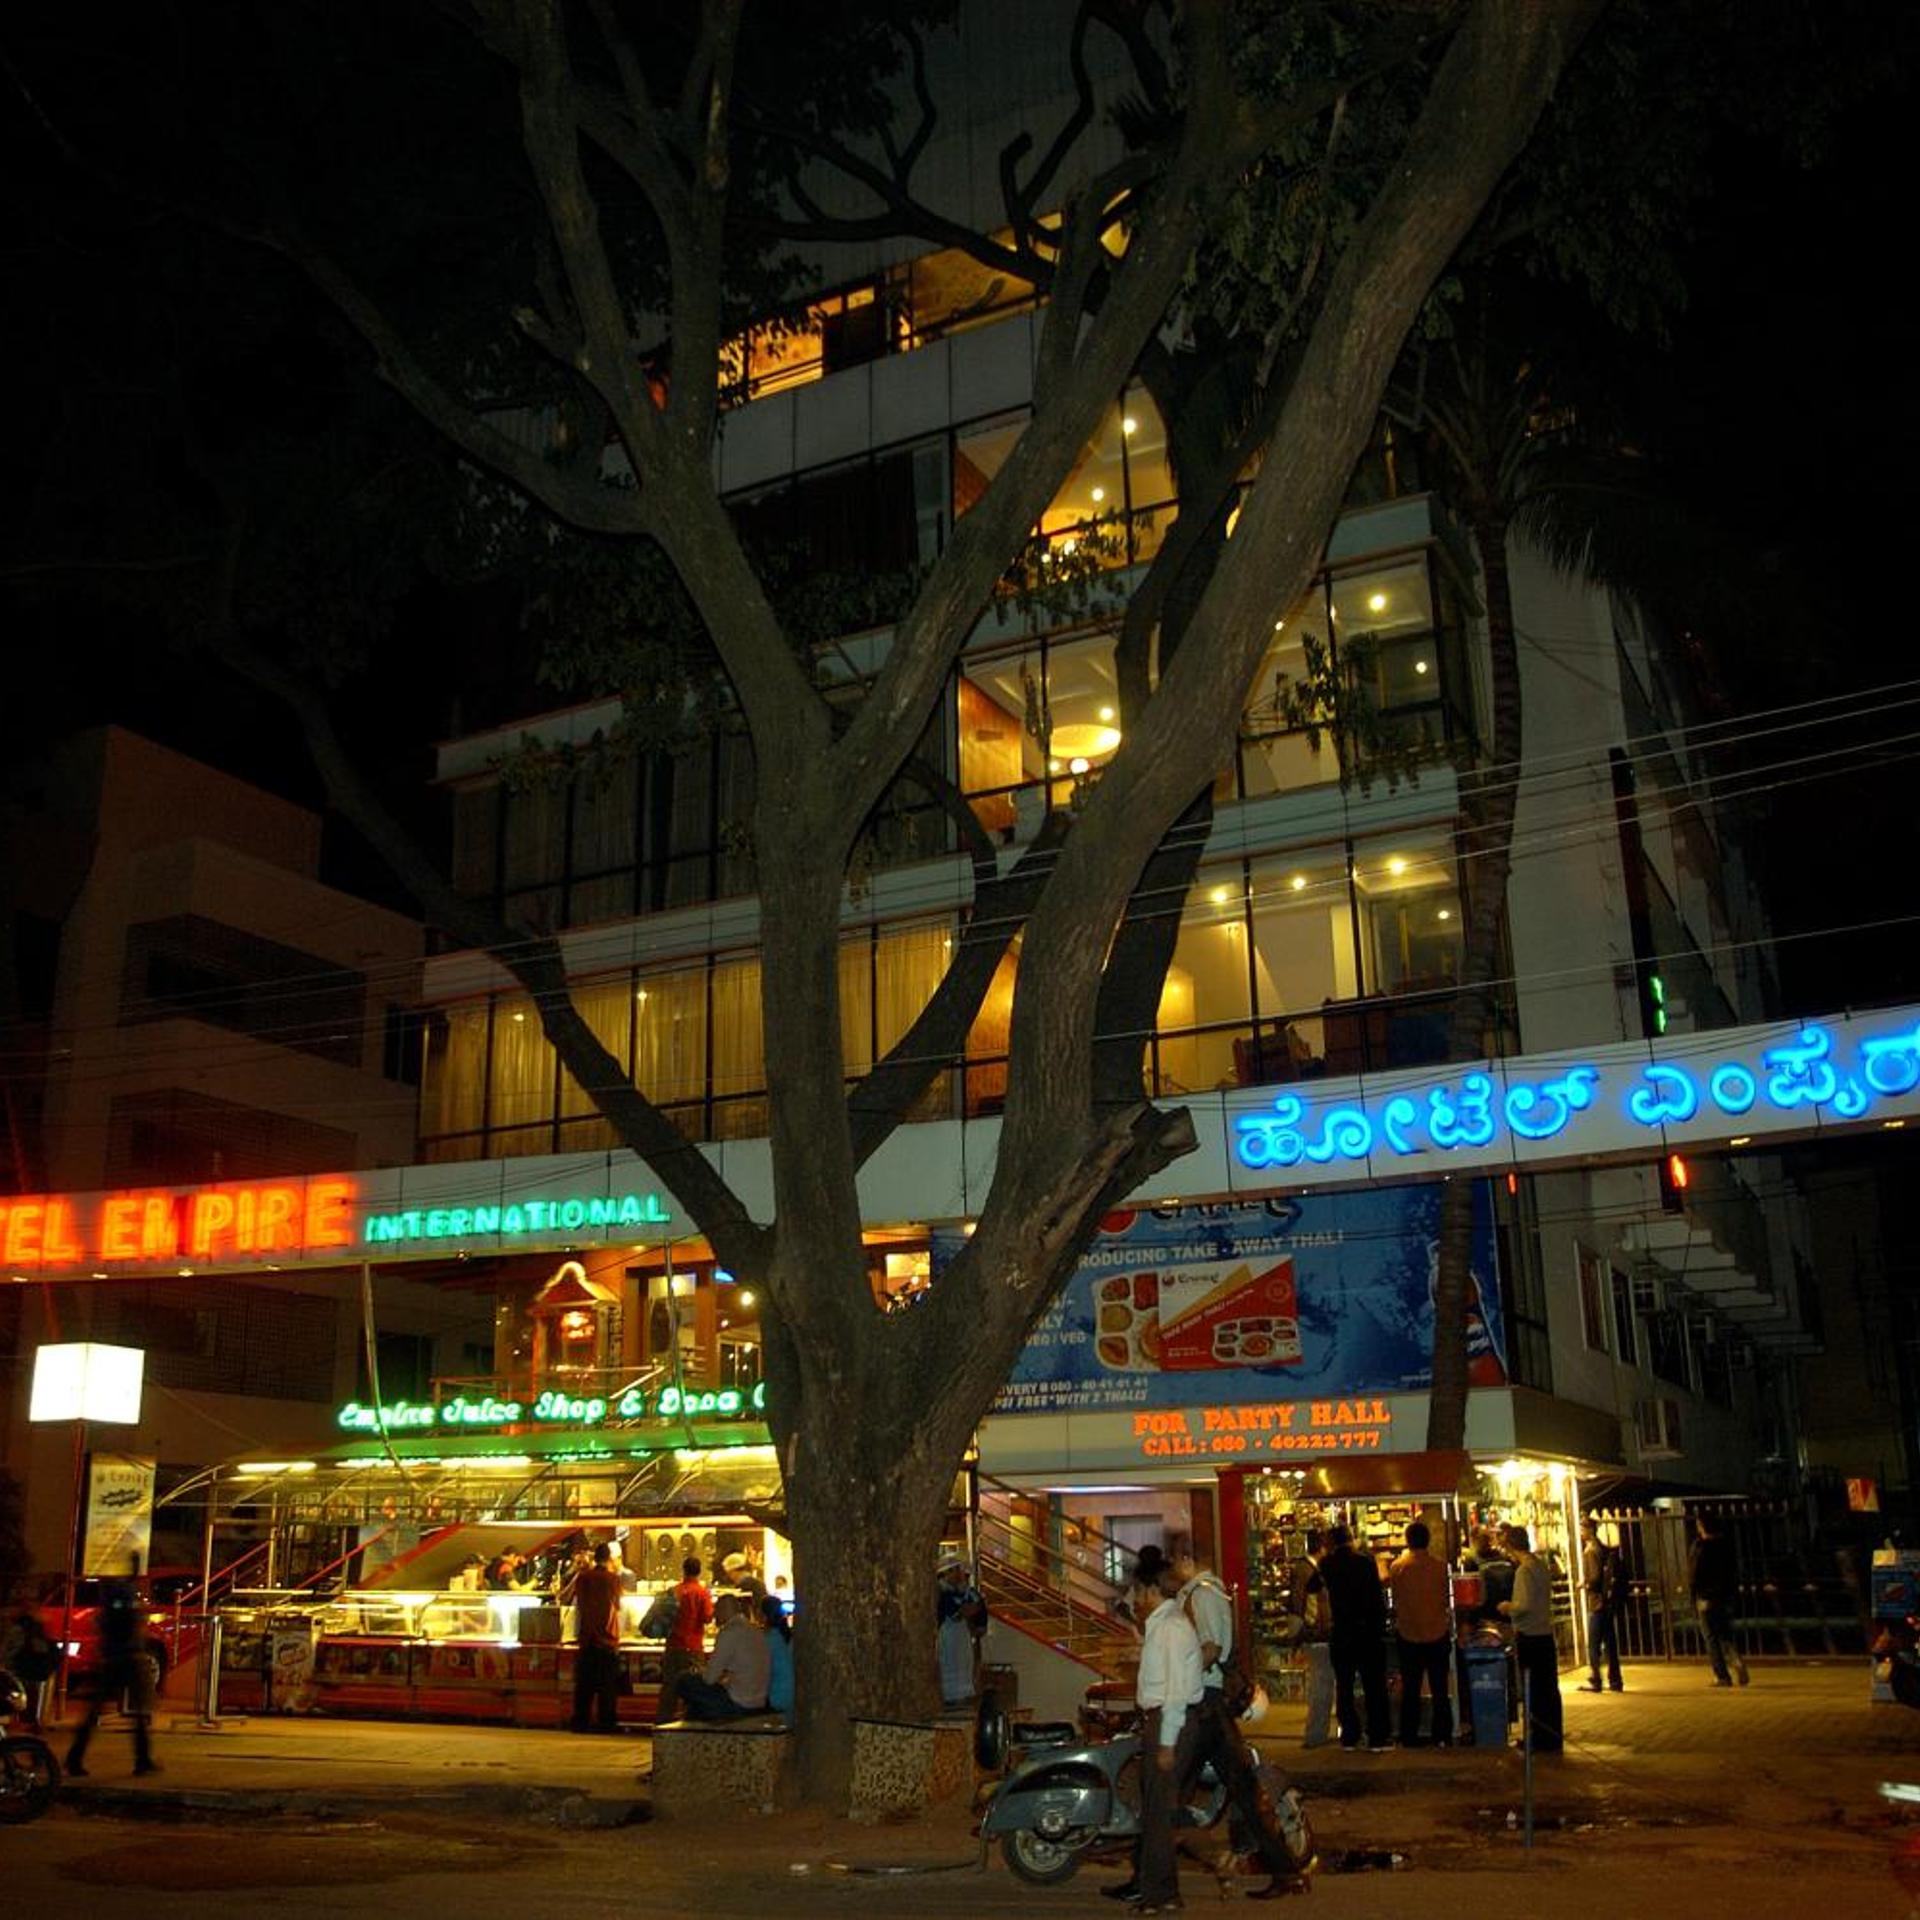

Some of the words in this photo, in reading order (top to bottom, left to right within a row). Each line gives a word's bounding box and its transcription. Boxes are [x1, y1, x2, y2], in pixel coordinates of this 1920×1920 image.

[1235, 1064, 1598, 1168] ಹೋಟೆಲ್
[0, 1201, 78, 1262] EL
[100, 1180, 350, 1258] EMPIRE
[365, 1195, 670, 1242] INTERNATIONAL
[1078, 1247, 1167, 1270] RODUCING
[1171, 1241, 1218, 1260] TAKE
[1231, 1236, 1283, 1254] AWAY
[442, 1397, 521, 1423] Juice
[534, 1391, 607, 1424] Shop
[620, 1389, 642, 1415] &
[998, 1382, 1038, 1396] IVERY
[1134, 1411, 1187, 1436] FOR
[1203, 1405, 1295, 1432] PARTY
[1310, 1400, 1391, 1427] HALL
